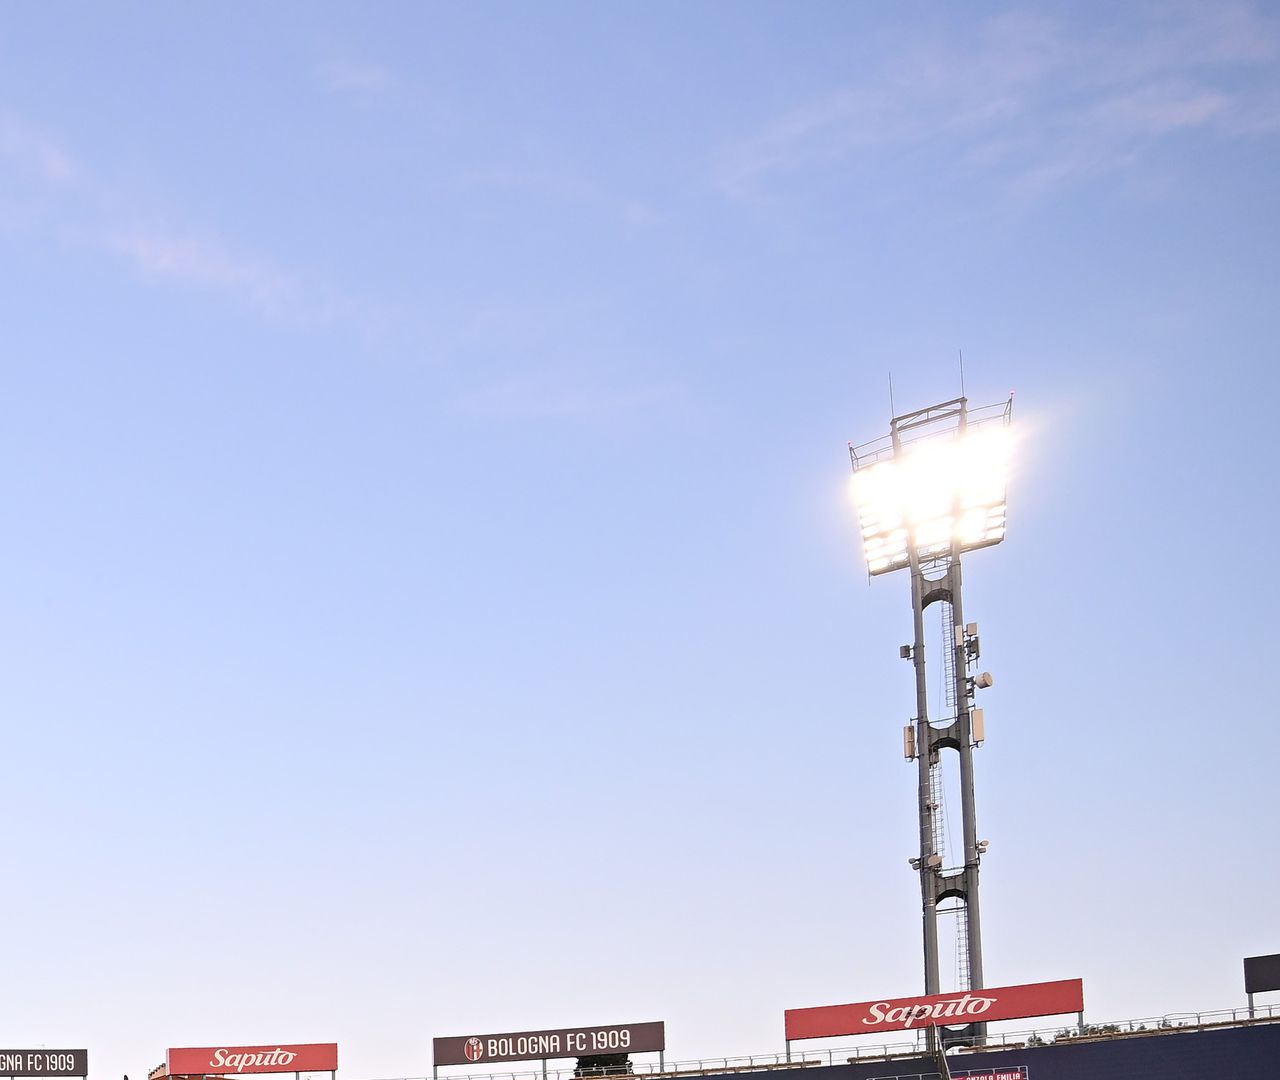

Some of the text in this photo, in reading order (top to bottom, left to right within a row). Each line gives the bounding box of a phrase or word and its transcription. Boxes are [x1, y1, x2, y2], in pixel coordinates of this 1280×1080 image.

[862, 994, 997, 1027] Saputo
[488, 1029, 631, 1057] BOLOGNA FC 1909
[27, 1054, 42, 1071] FC
[46, 1054, 75, 1071] 1909
[209, 1047, 297, 1073] Saputo
[997, 1073, 1021, 1080] EMILIA
